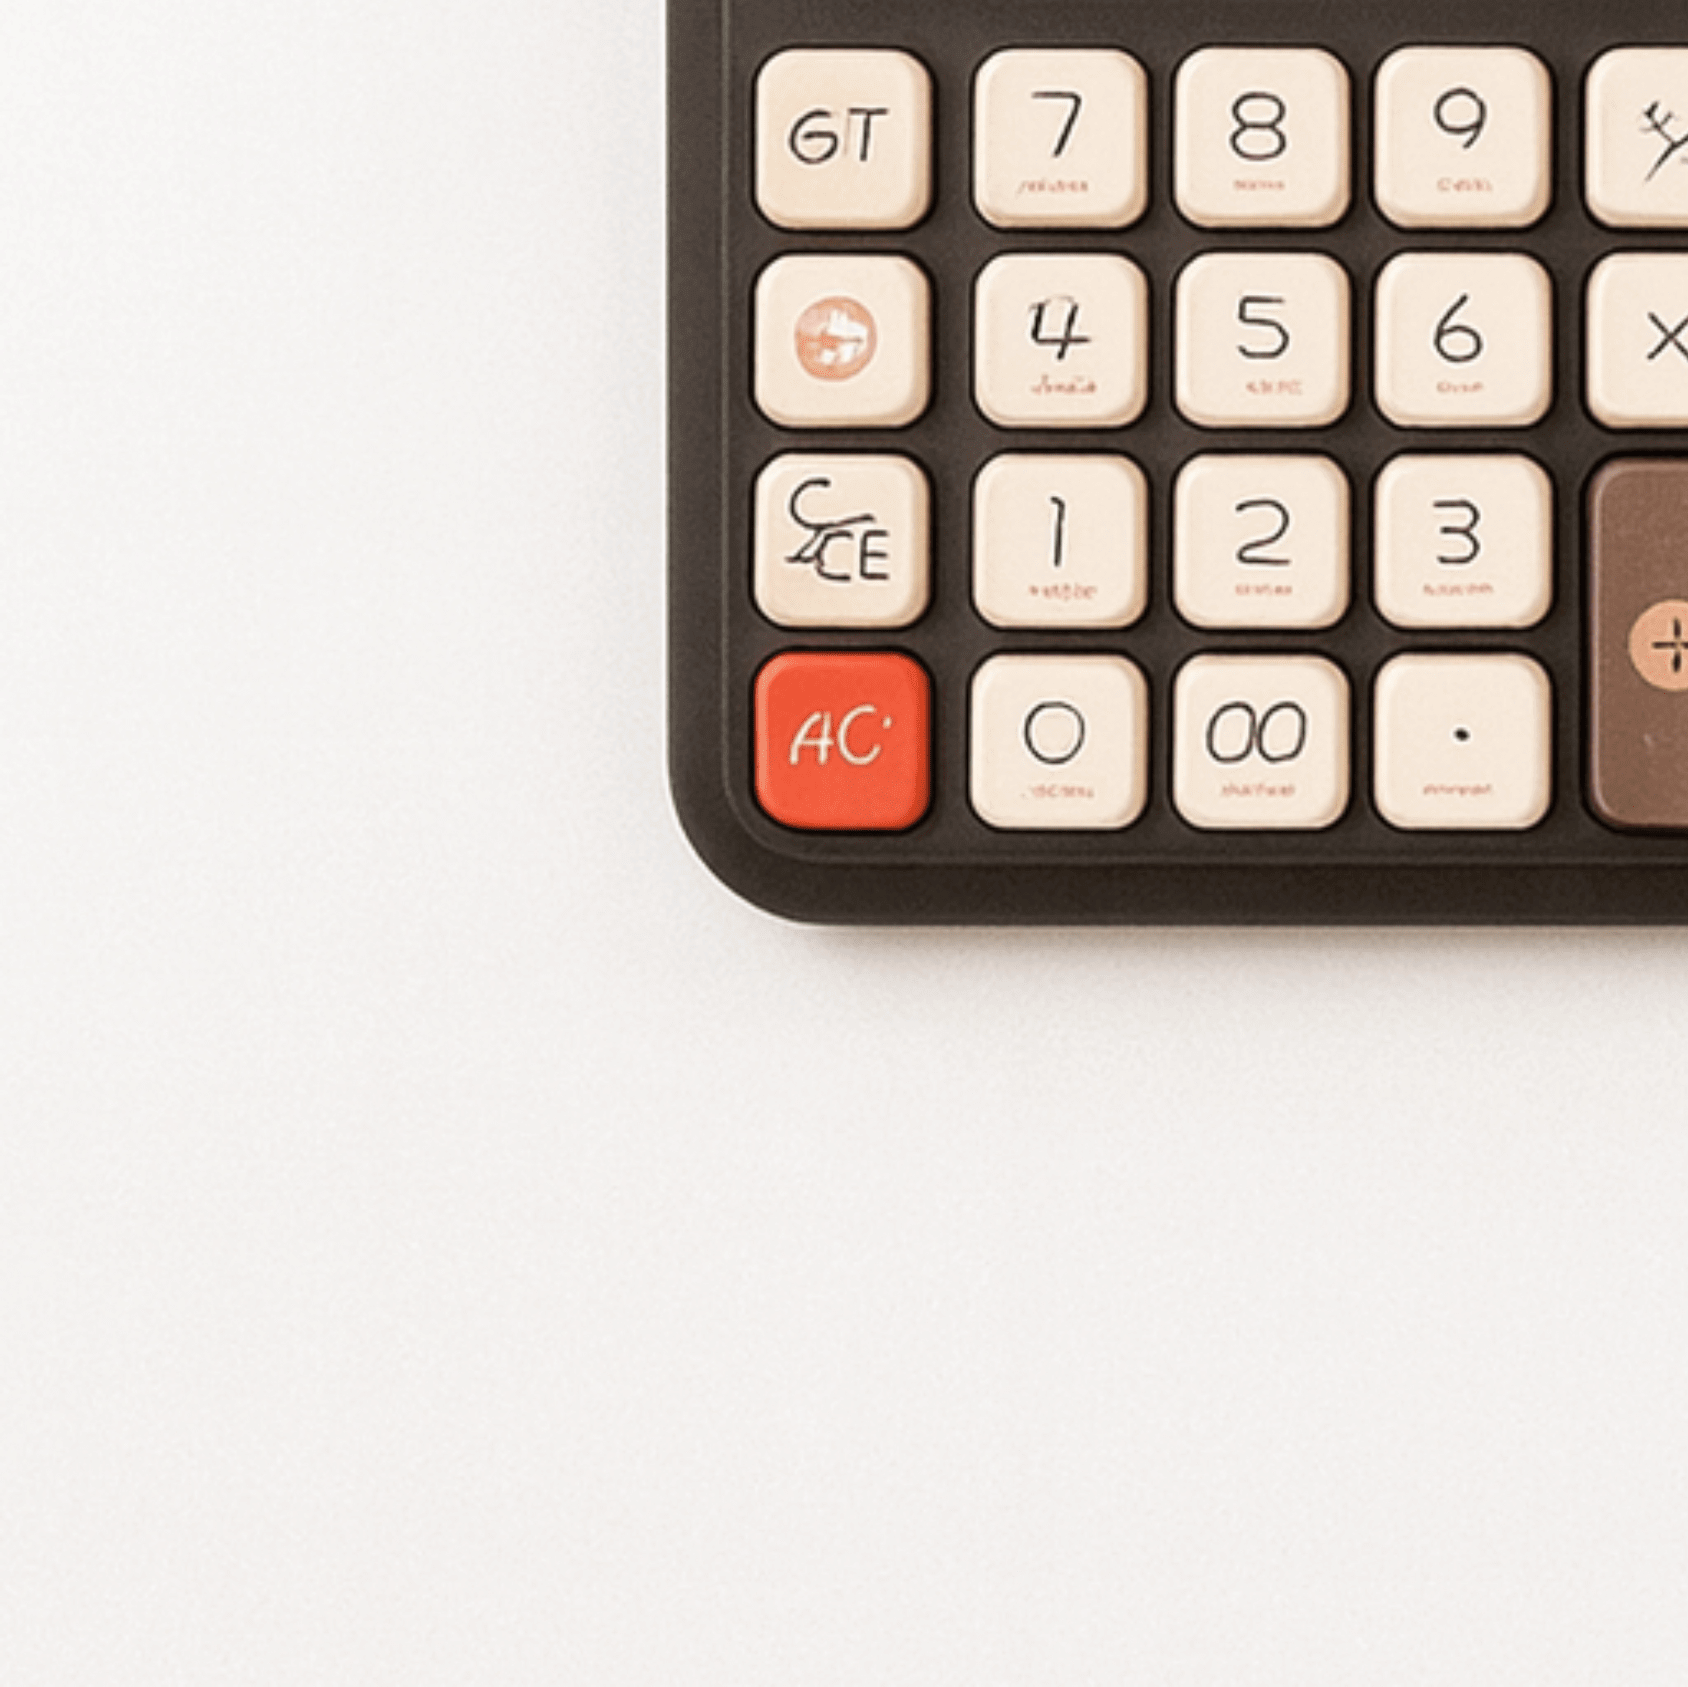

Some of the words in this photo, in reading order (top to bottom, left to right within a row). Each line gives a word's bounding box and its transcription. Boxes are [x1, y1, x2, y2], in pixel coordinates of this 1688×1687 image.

[788, 107, 889, 165] GT
[1033, 90, 1083, 158] 7
[1229, 91, 1288, 161] 8
[1433, 87, 1488, 150] 9
[1029, 300, 1092, 361] 4
[1237, 294, 1290, 360] 5
[1433, 293, 1483, 363] 6
[1049, 495, 1067, 568] 1
[1235, 499, 1291, 566] 2
[1433, 498, 1480, 565] 3
[1205, 700, 1307, 765] 00
